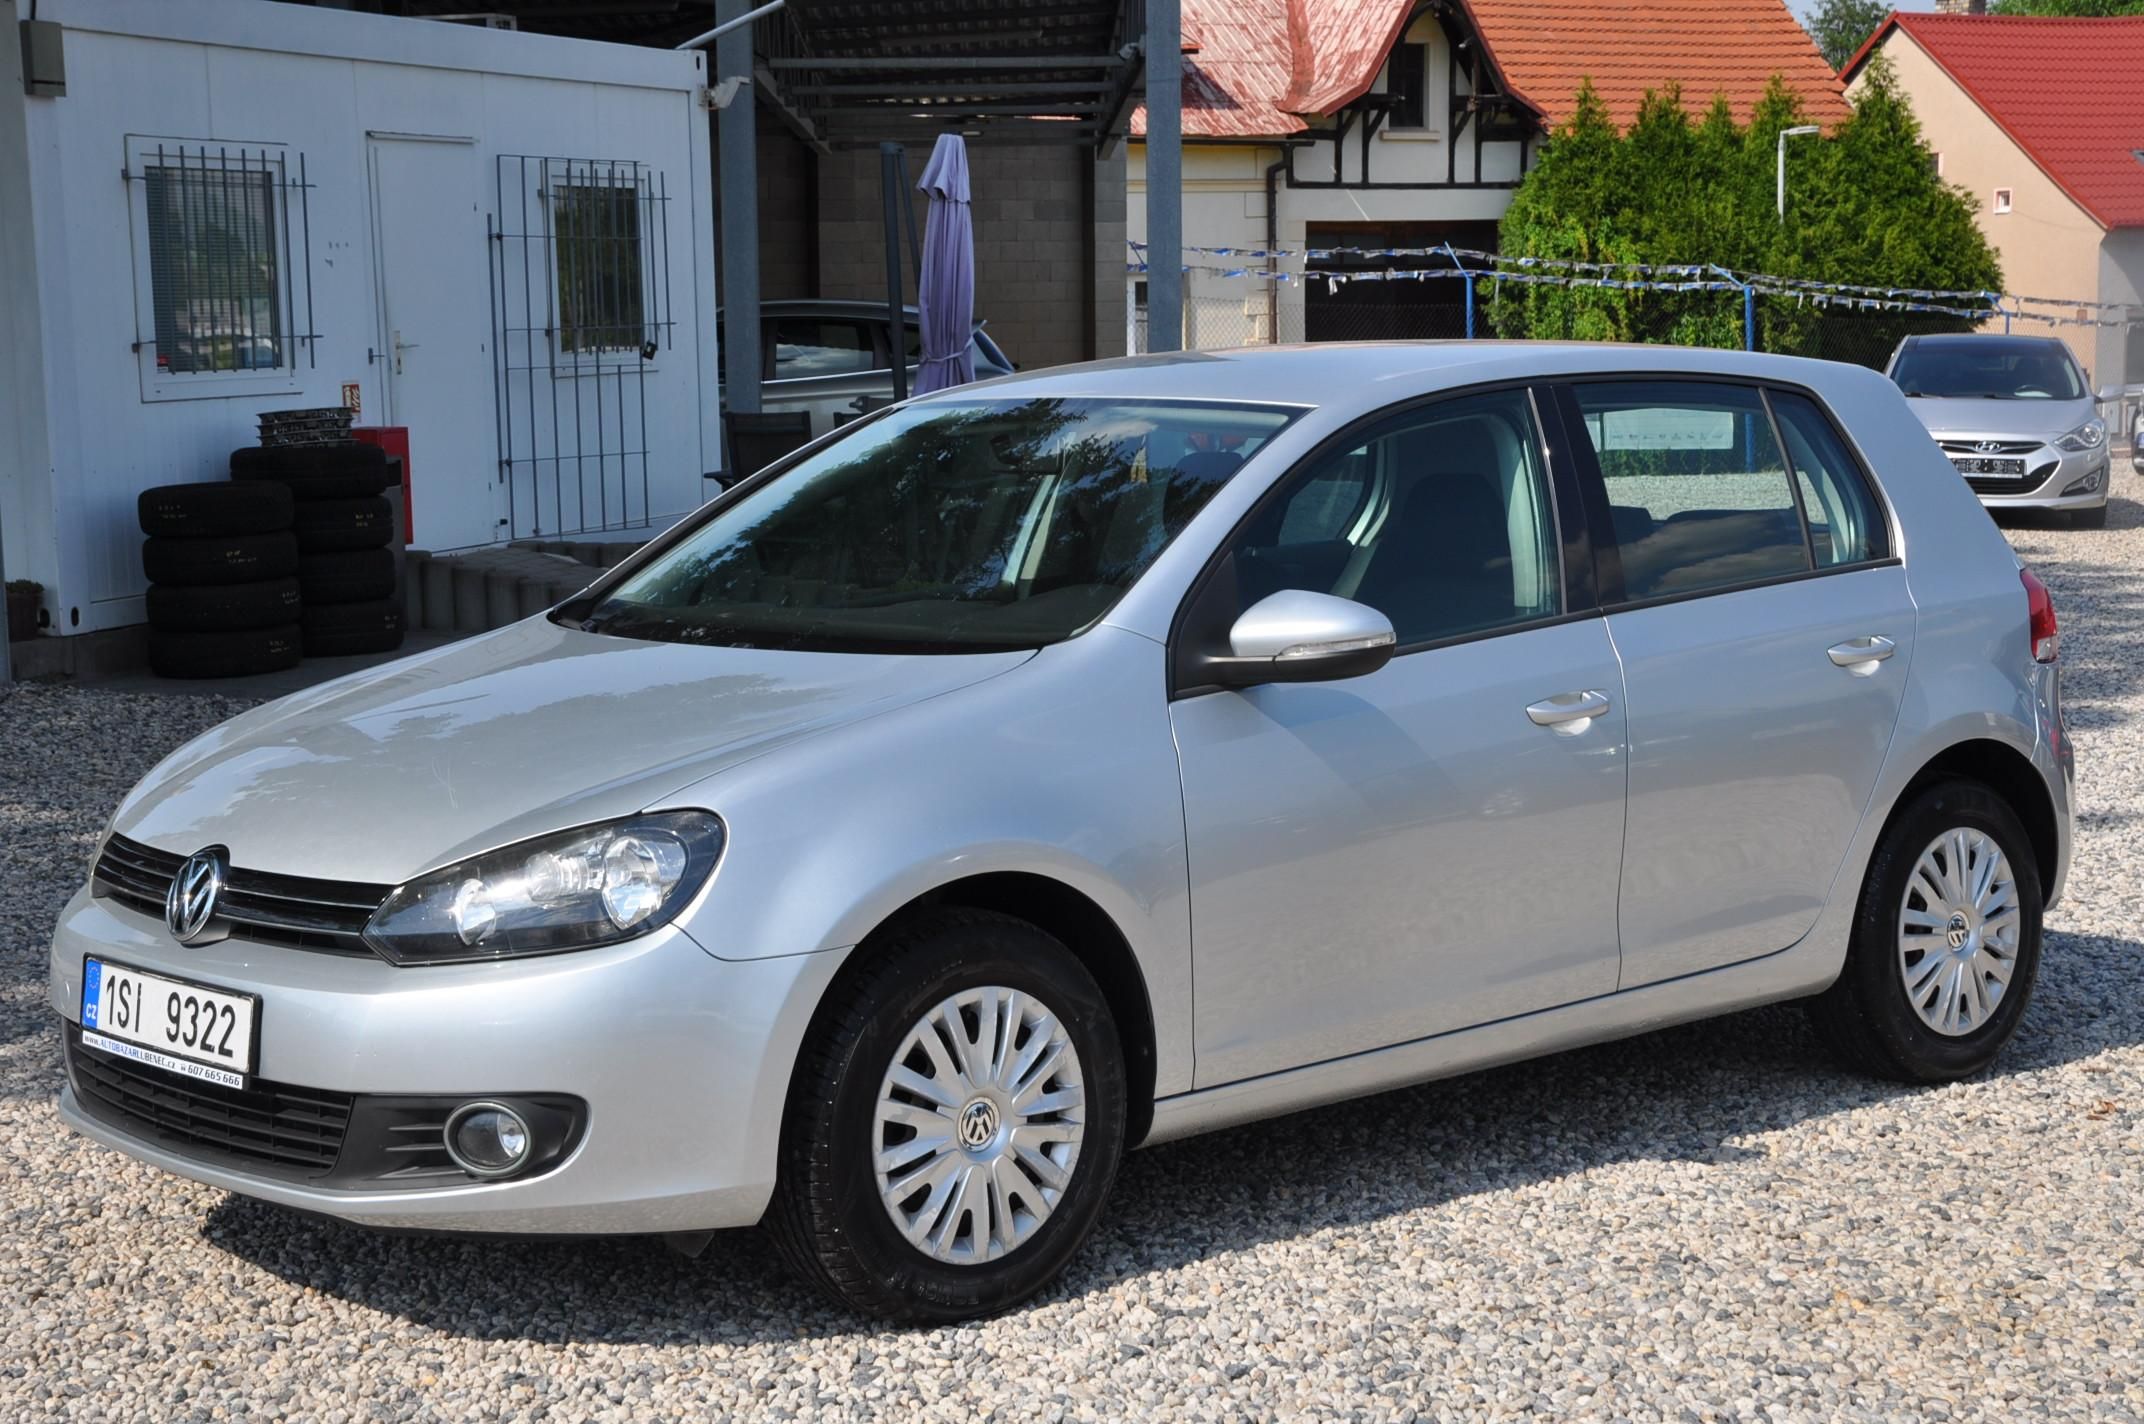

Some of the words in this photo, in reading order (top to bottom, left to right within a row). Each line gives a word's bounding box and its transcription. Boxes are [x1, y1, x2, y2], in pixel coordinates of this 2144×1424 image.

[85, 1002, 97, 1020] CZ
[106, 975, 142, 1033] 1SI
[166, 991, 236, 1058] 9322
[187, 1065, 204, 1077] 607
[204, 1069, 221, 1081] 665
[222, 1073, 241, 1086] 666
